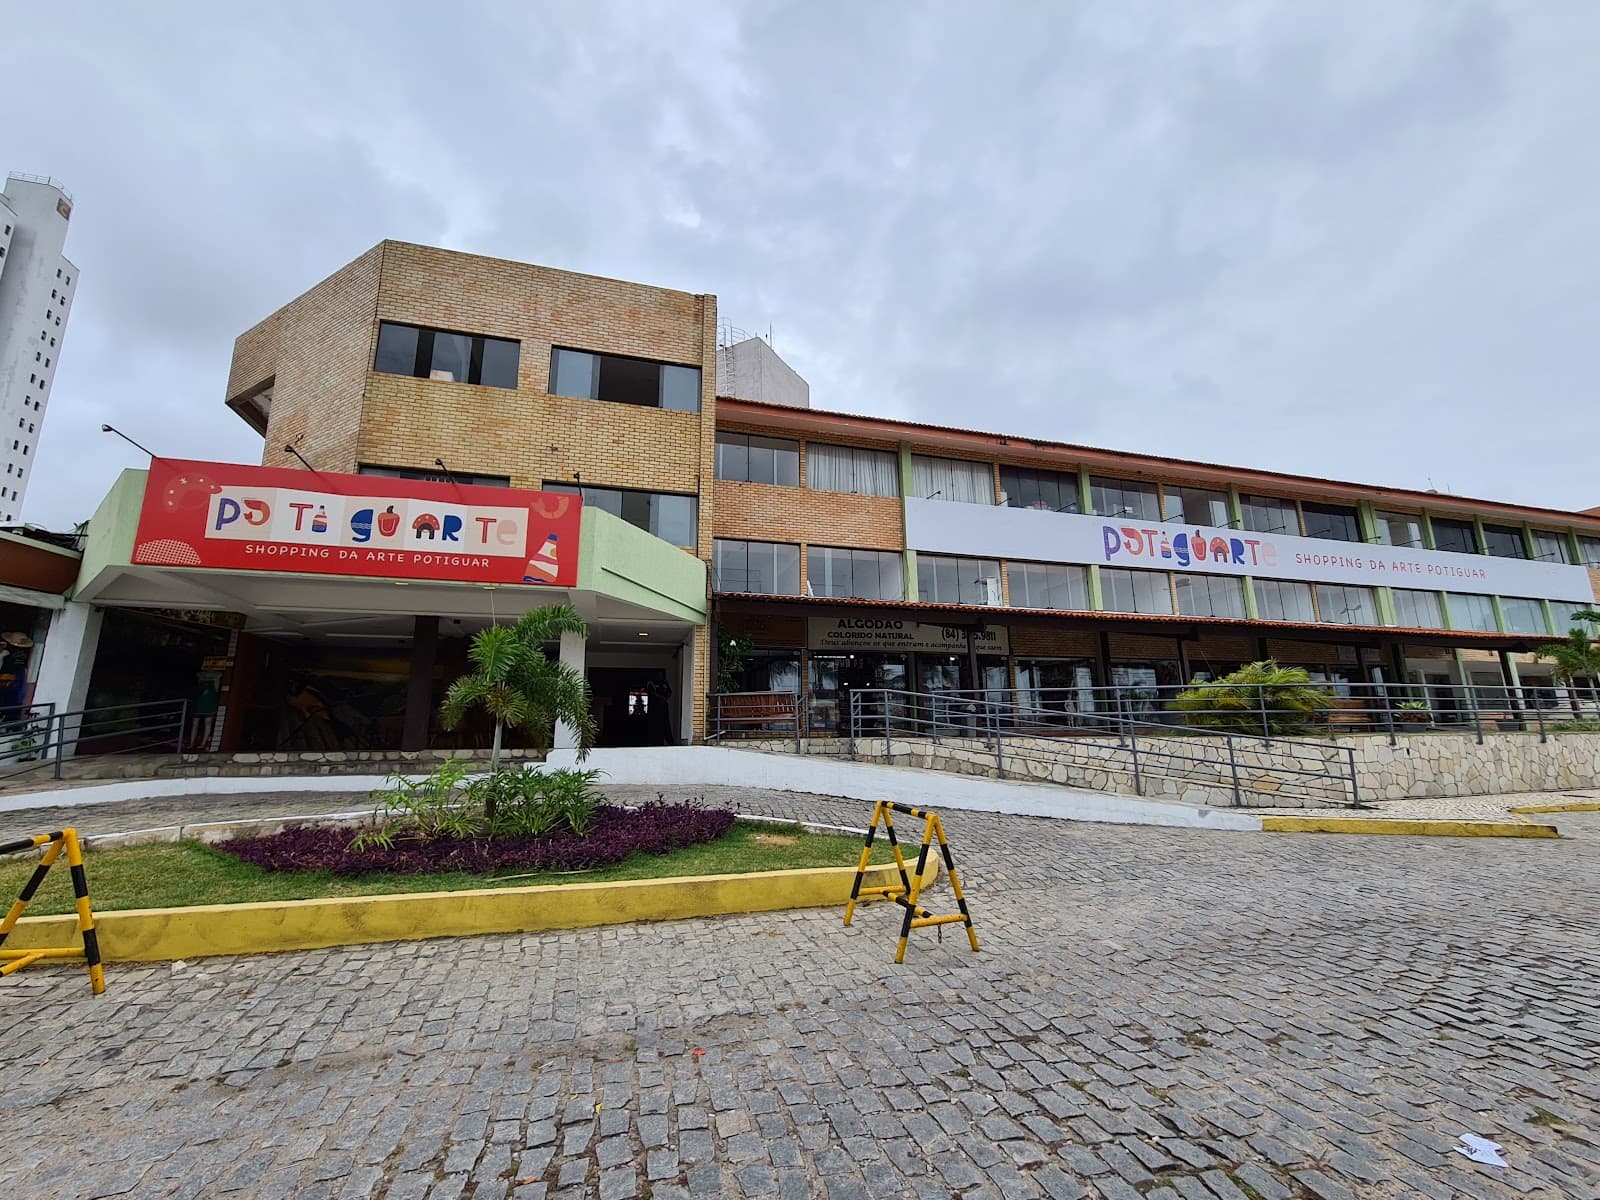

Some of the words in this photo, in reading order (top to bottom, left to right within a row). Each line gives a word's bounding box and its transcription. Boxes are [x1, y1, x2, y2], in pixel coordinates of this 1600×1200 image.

[245, 544, 330, 558] SHOPPING
[338, 549, 358, 560] DA
[366, 551, 405, 562] ARTE
[413, 554, 490, 567] POTIGUAR
[1295, 553, 1363, 569] SHOPPING
[1369, 560, 1386, 571] DA
[1392, 561, 1421, 573] ARTE
[1427, 564, 1486, 580] POTIGUAR
[827, 631, 873, 640] COLORIDO
[942, 627, 959, 642] (84)
